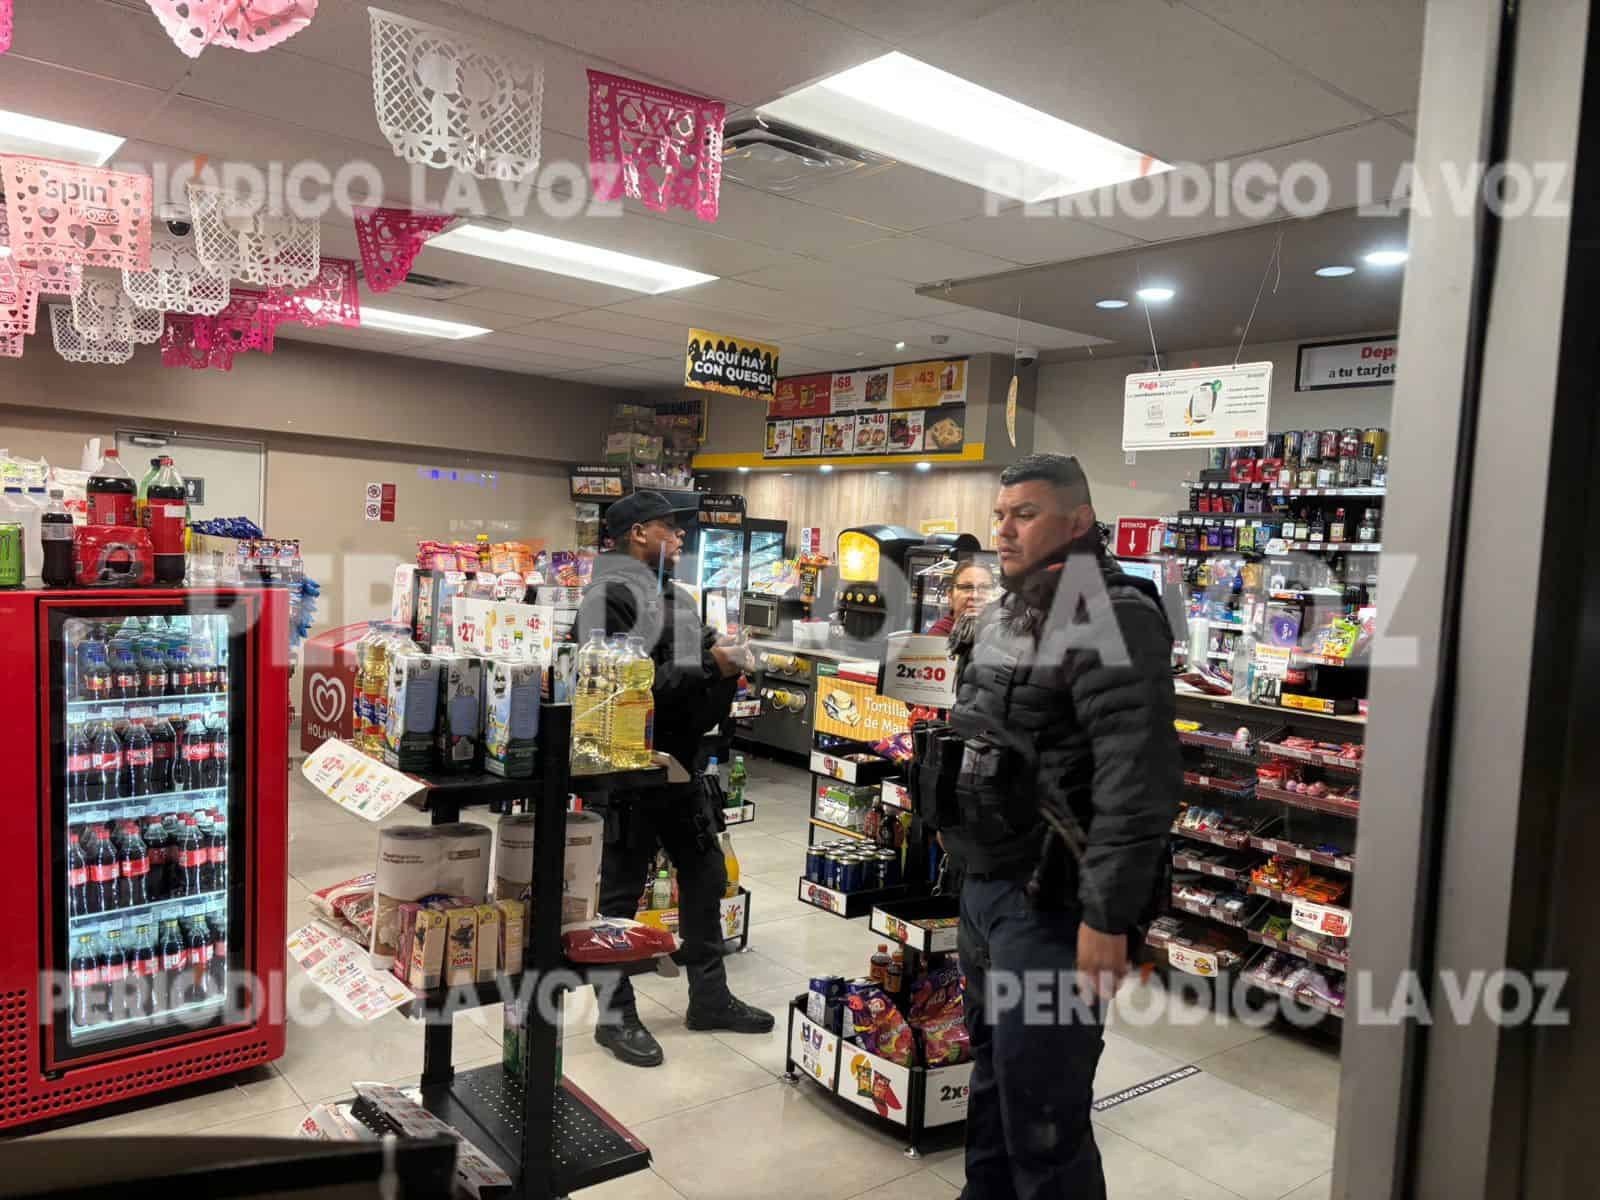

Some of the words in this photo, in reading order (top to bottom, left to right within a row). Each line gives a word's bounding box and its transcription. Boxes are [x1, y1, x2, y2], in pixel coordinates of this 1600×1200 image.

[45, 178, 108, 204] spin
[1361, 345, 1397, 361] Dep
[741, 356, 767, 370] HAY
[694, 361, 723, 376] CON
[726, 367, 771, 384] QUESO!
[1328, 368, 1336, 378] a
[1339, 367, 1353, 378] tu
[896, 663, 947, 682] 2x$30
[864, 716, 879, 729] de
